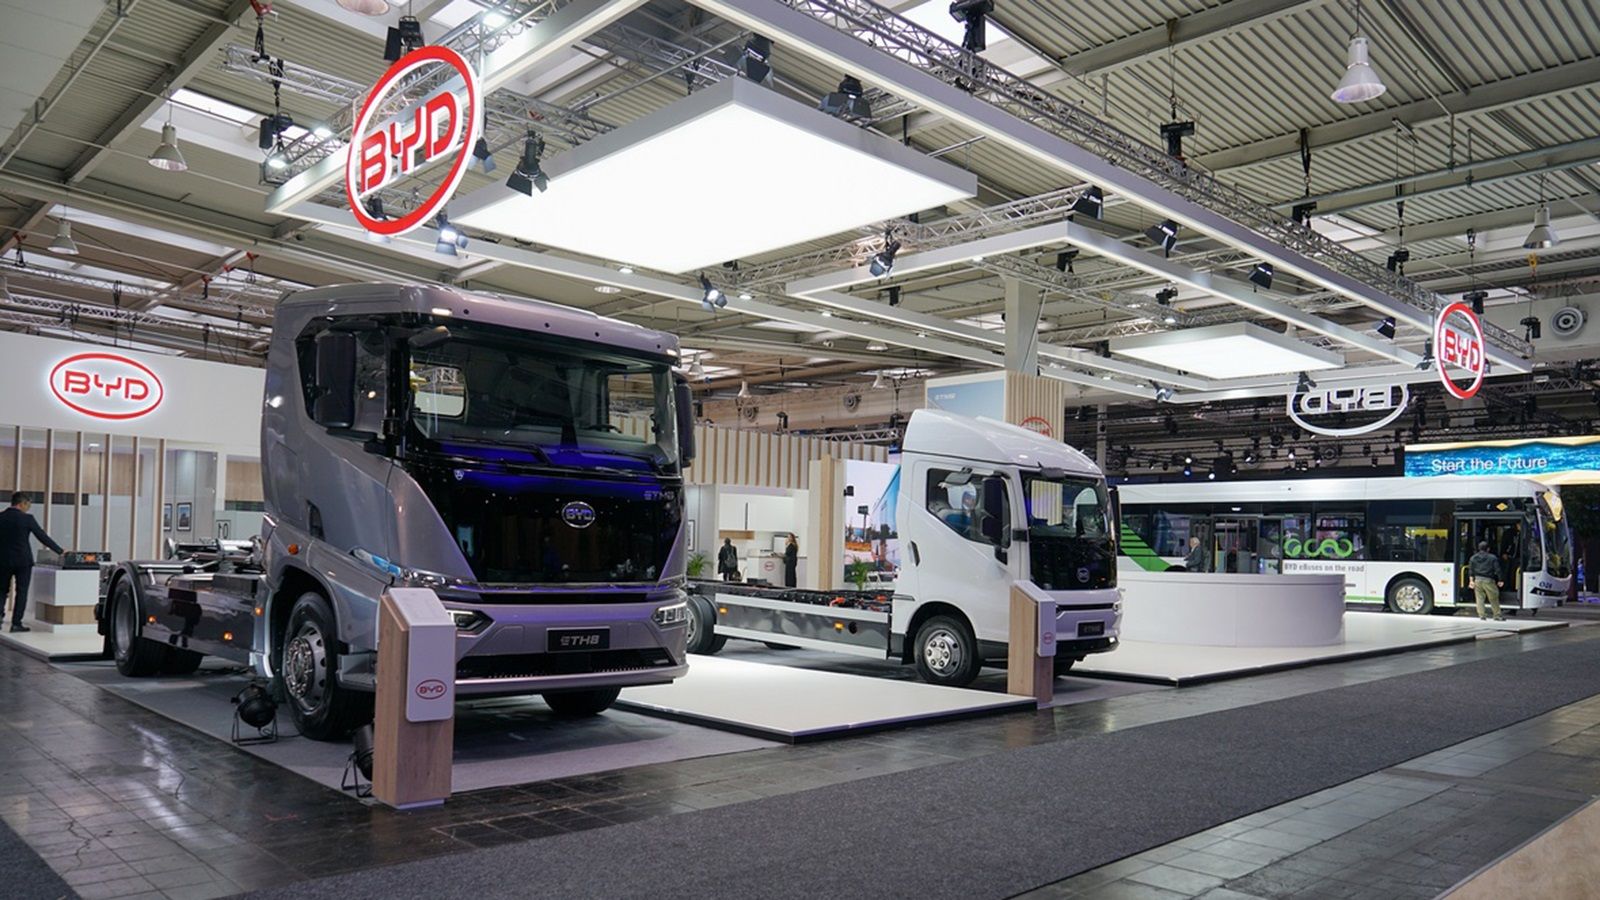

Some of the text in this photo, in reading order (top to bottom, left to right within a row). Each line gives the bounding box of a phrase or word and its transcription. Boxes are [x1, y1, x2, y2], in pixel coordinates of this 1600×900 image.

[361, 91, 459, 193] BYD
[1445, 328, 1479, 372] BYD
[64, 370, 149, 401] BYD
[1432, 457, 1548, 472] Start the Future
[566, 508, 592, 520] BYD
[1299, 563, 1323, 571] eBuses
[1335, 564, 1346, 572] the
[560, 634, 599, 645] ETH8
[419, 685, 443, 694] BYD
